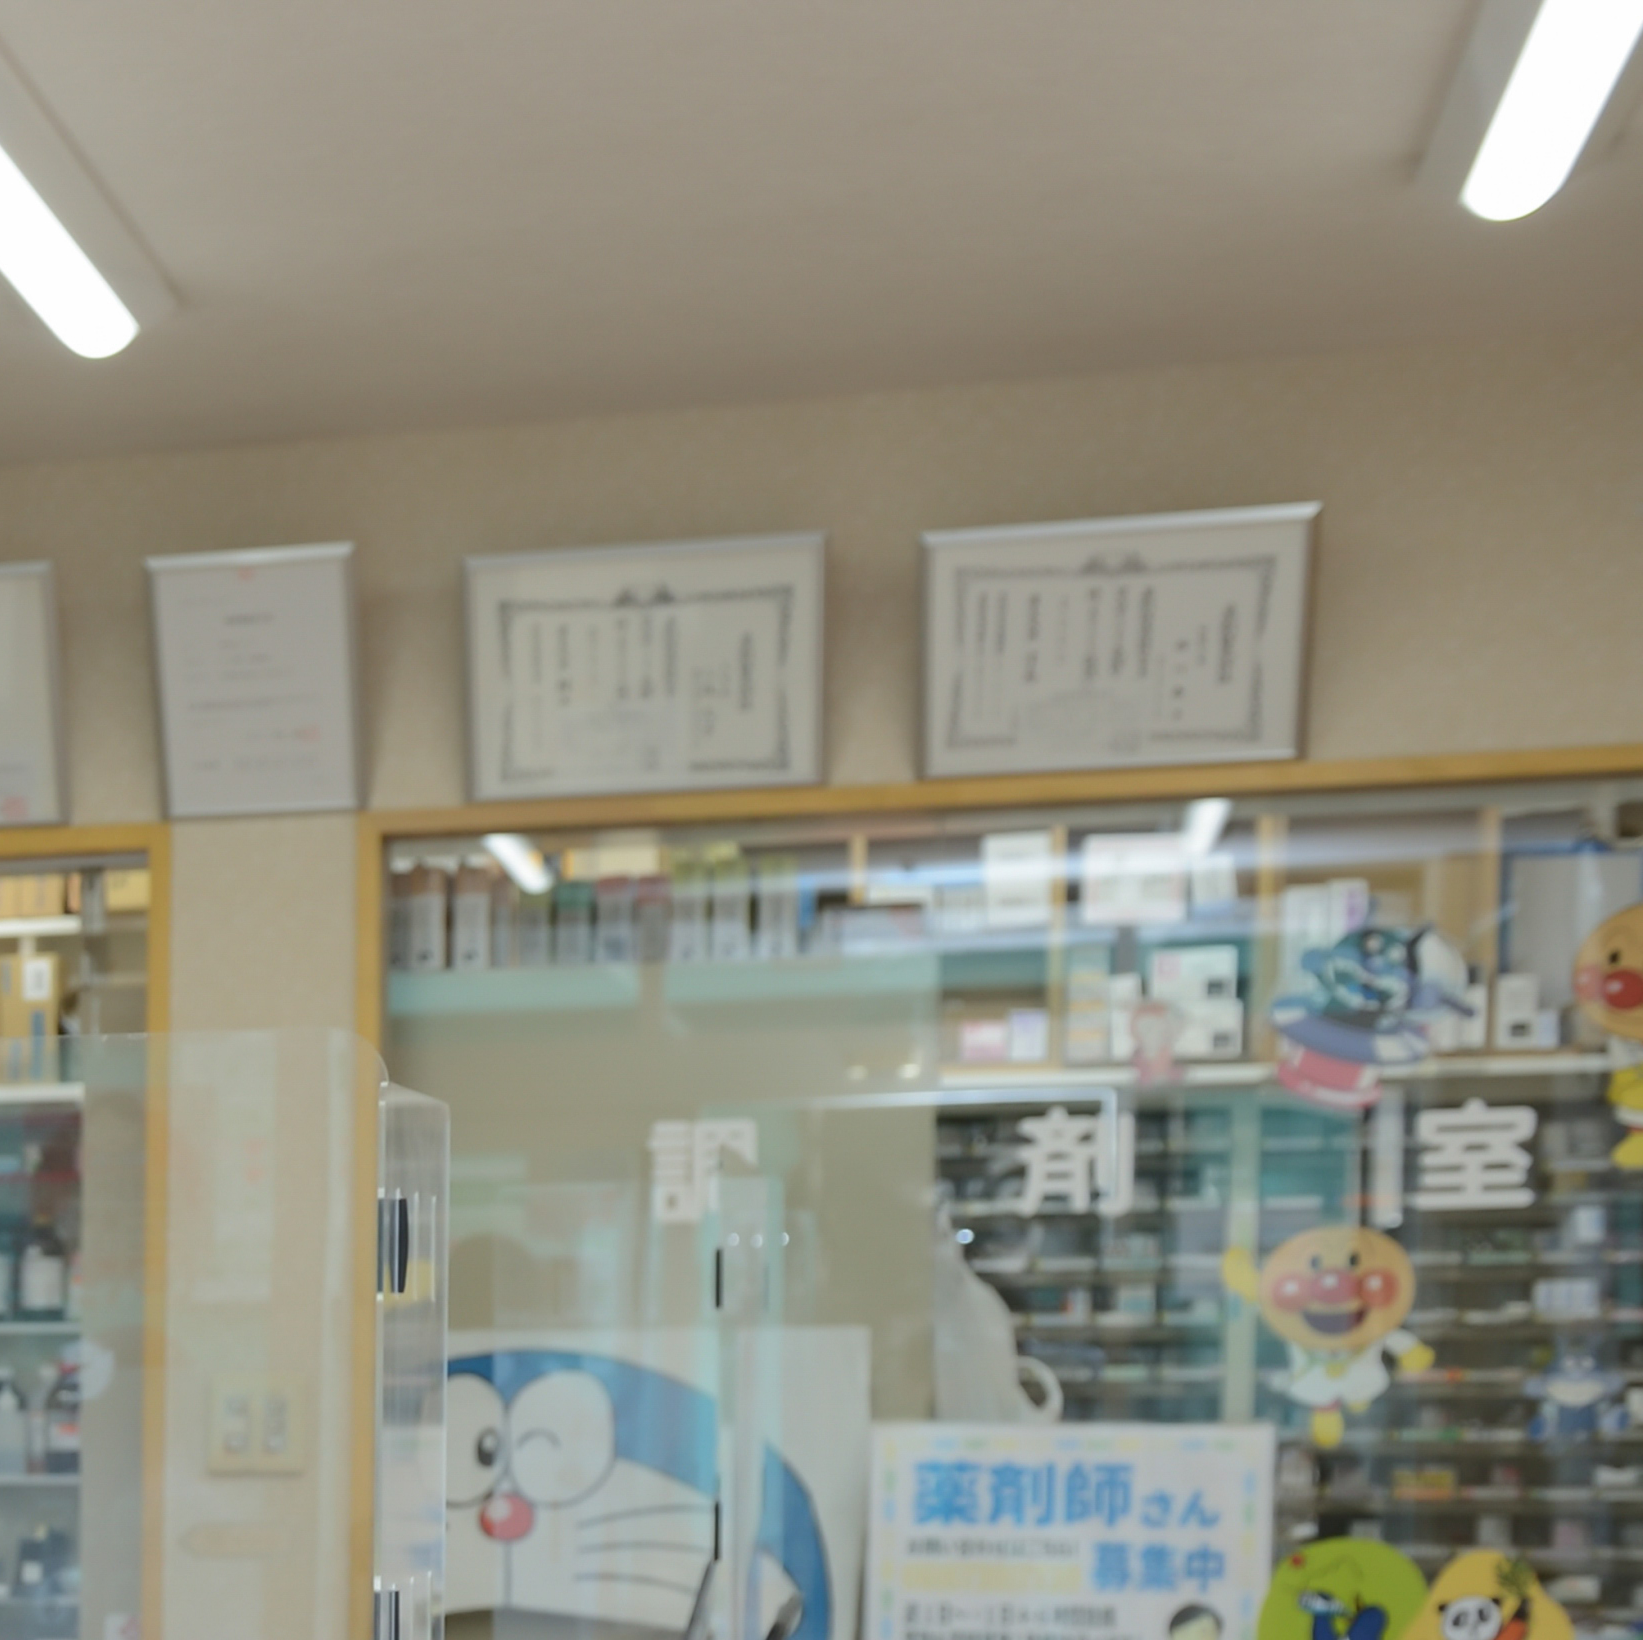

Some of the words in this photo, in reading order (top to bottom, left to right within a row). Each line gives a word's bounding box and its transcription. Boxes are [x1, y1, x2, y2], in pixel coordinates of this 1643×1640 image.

[912, 1458, 1222, 1529] 薬剤師さん
[1092, 1540, 1227, 1593] 募集中
